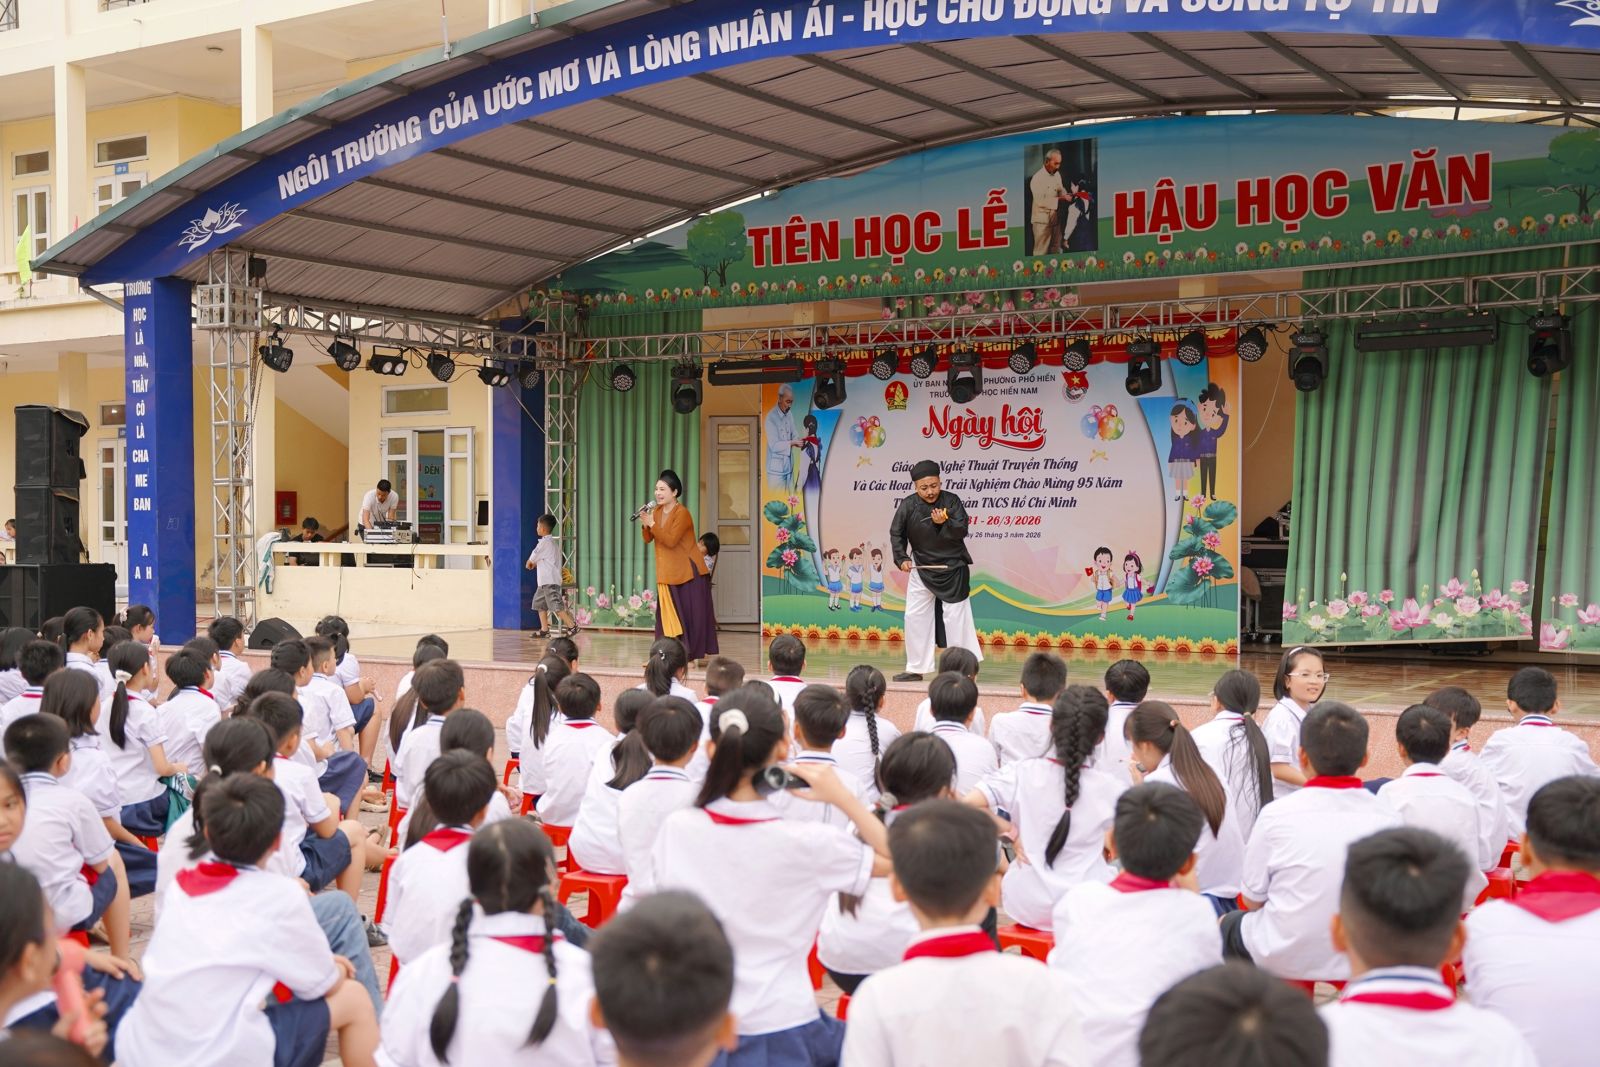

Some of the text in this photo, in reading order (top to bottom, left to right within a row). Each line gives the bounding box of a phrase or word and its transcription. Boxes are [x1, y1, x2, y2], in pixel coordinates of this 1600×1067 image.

[277, 152, 331, 200] NGÔI
[331, 115, 423, 174] TRƯỜNG
[428, 91, 479, 136] CỦA
[483, 75, 534, 116] ƯỚC
[538, 58, 580, 100] MƠ
[586, 45, 622, 86] VÀ
[629, 30, 701, 75] LÒNG
[708, 8, 793, 56] NHÂN
[802, 0, 835, 39] ÁI
[863, 0, 928, 36] HỌC
[852, 210, 943, 266] HỌC
[955, 187, 1010, 251] LỄ
[1113, 177, 1219, 245] HẬU
[1236, 168, 1350, 233] HỌC
[1366, 146, 1493, 214] VĂN
[133, 307, 147, 324] HỌC
[135, 329, 144, 345] LÀ
[913, 378, 925, 388] ỦY
[925, 380, 941, 388] BAN
[983, 376, 1017, 384] PHƯỜNG
[1018, 374, 1036, 383] PHỐ
[930, 391, 950, 399] TRƯỜ
[981, 389, 998, 397] HỌC
[1020, 387, 1038, 395] NAM
[136, 400, 145, 417] CÔ
[136, 422, 145, 439] LÀ
[922, 403, 1046, 450] Ngày hội
[132, 449, 149, 463] CHA
[940, 460, 966, 474] Nghệ
[968, 459, 999, 474] Thuật
[1002, 457, 1040, 473] Truyền
[1043, 457, 1079, 472] Thống
[135, 474, 148, 487] ME
[853, 480, 867, 491] Và
[868, 479, 887, 491] Các
[889, 479, 913, 493] Hoạt
[969, 478, 1011, 493] Nghiệm
[1013, 477, 1041, 489] Chào
[1042, 476, 1075, 491] Mừng
[1077, 476, 1093, 489] 95
[1095, 476, 1123, 488] Năm
[133, 497, 151, 511] BAN
[981, 497, 1010, 509] TNCS
[1011, 495, 1027, 508] Hồ
[1028, 496, 1047, 508] Chí
[1048, 496, 1077, 508] Minh
[987, 515, 1042, 527] 26/3/2026
[984, 531, 1003, 539] tháng
[142, 543, 149, 557] A
[134, 566, 152, 580] A H
